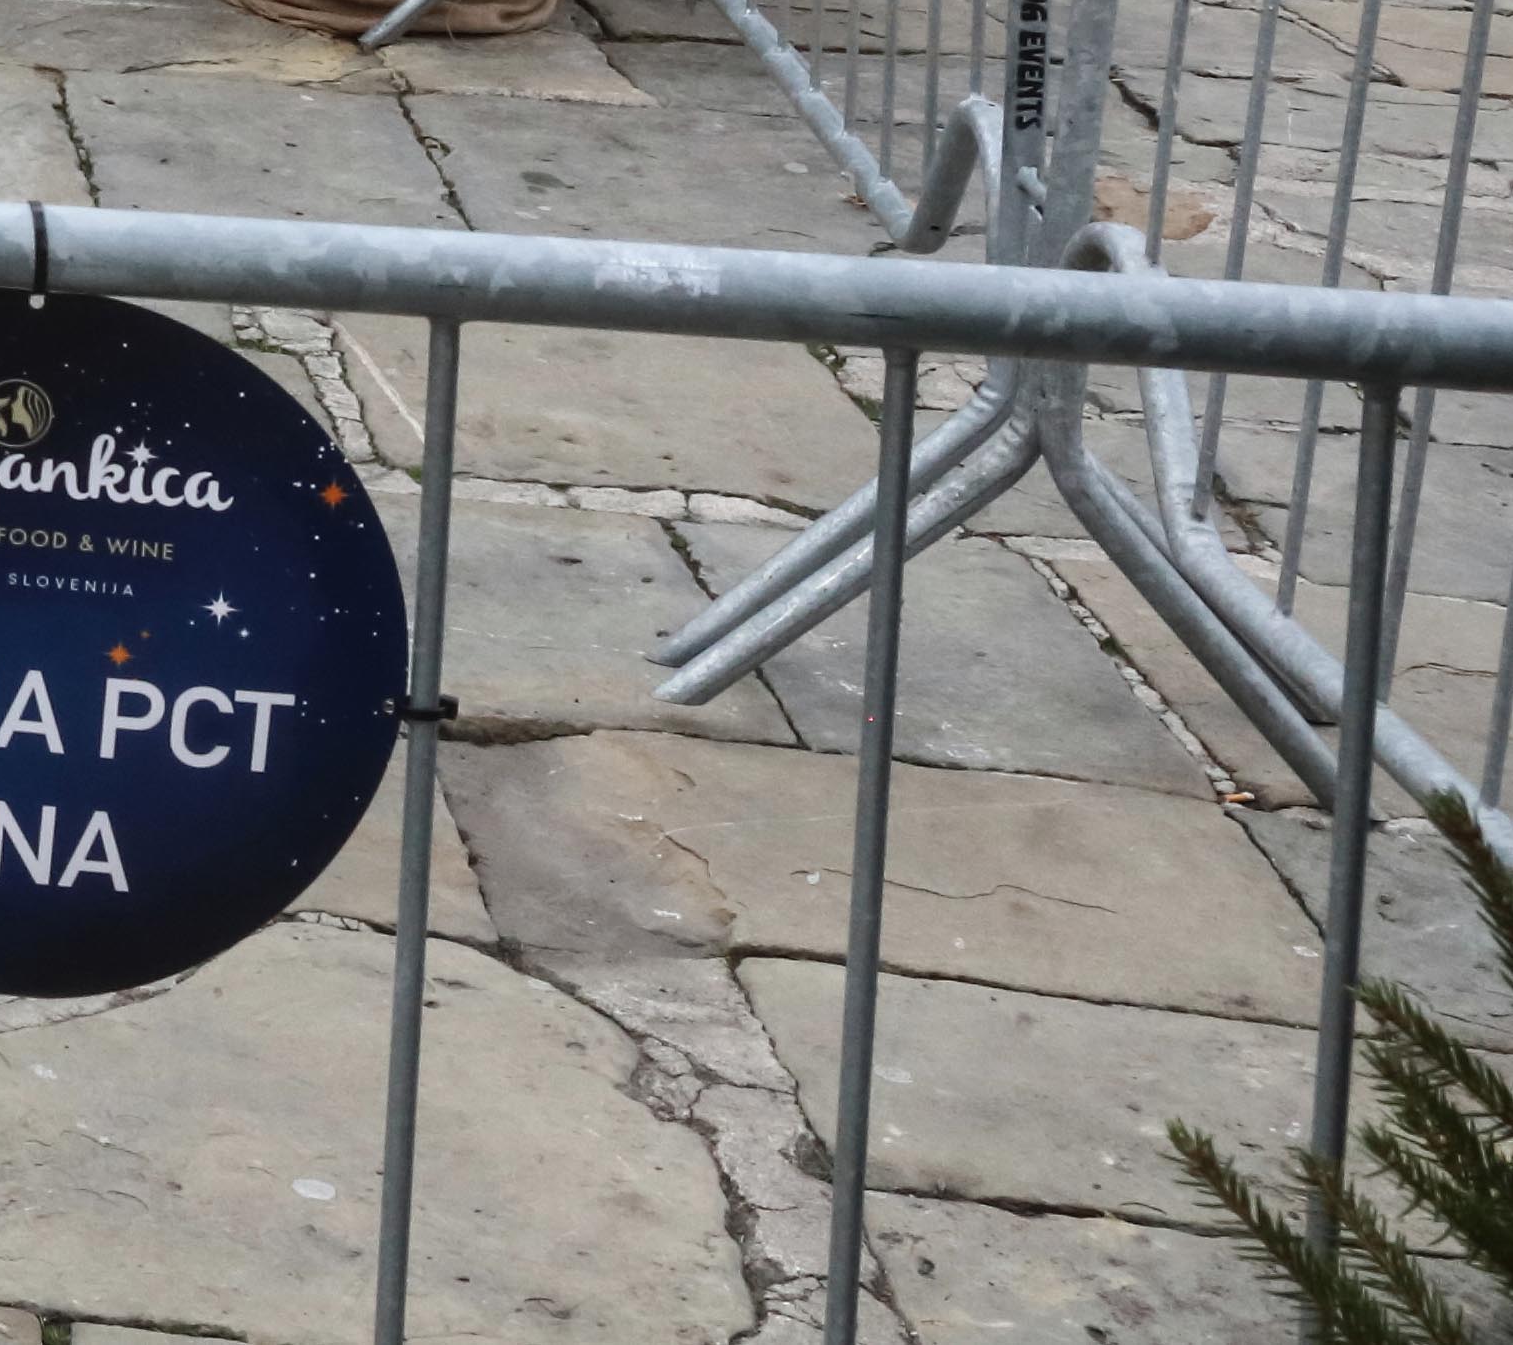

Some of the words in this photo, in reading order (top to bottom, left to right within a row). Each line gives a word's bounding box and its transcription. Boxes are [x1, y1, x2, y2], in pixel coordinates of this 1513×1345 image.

[1014, 29, 1047, 131] EVENTS
[79, 534, 95, 553] &
[106, 536, 176, 561] WINE
[8, 572, 135, 597] SLOVENIJA
[98, 676, 297, 774] PCT
